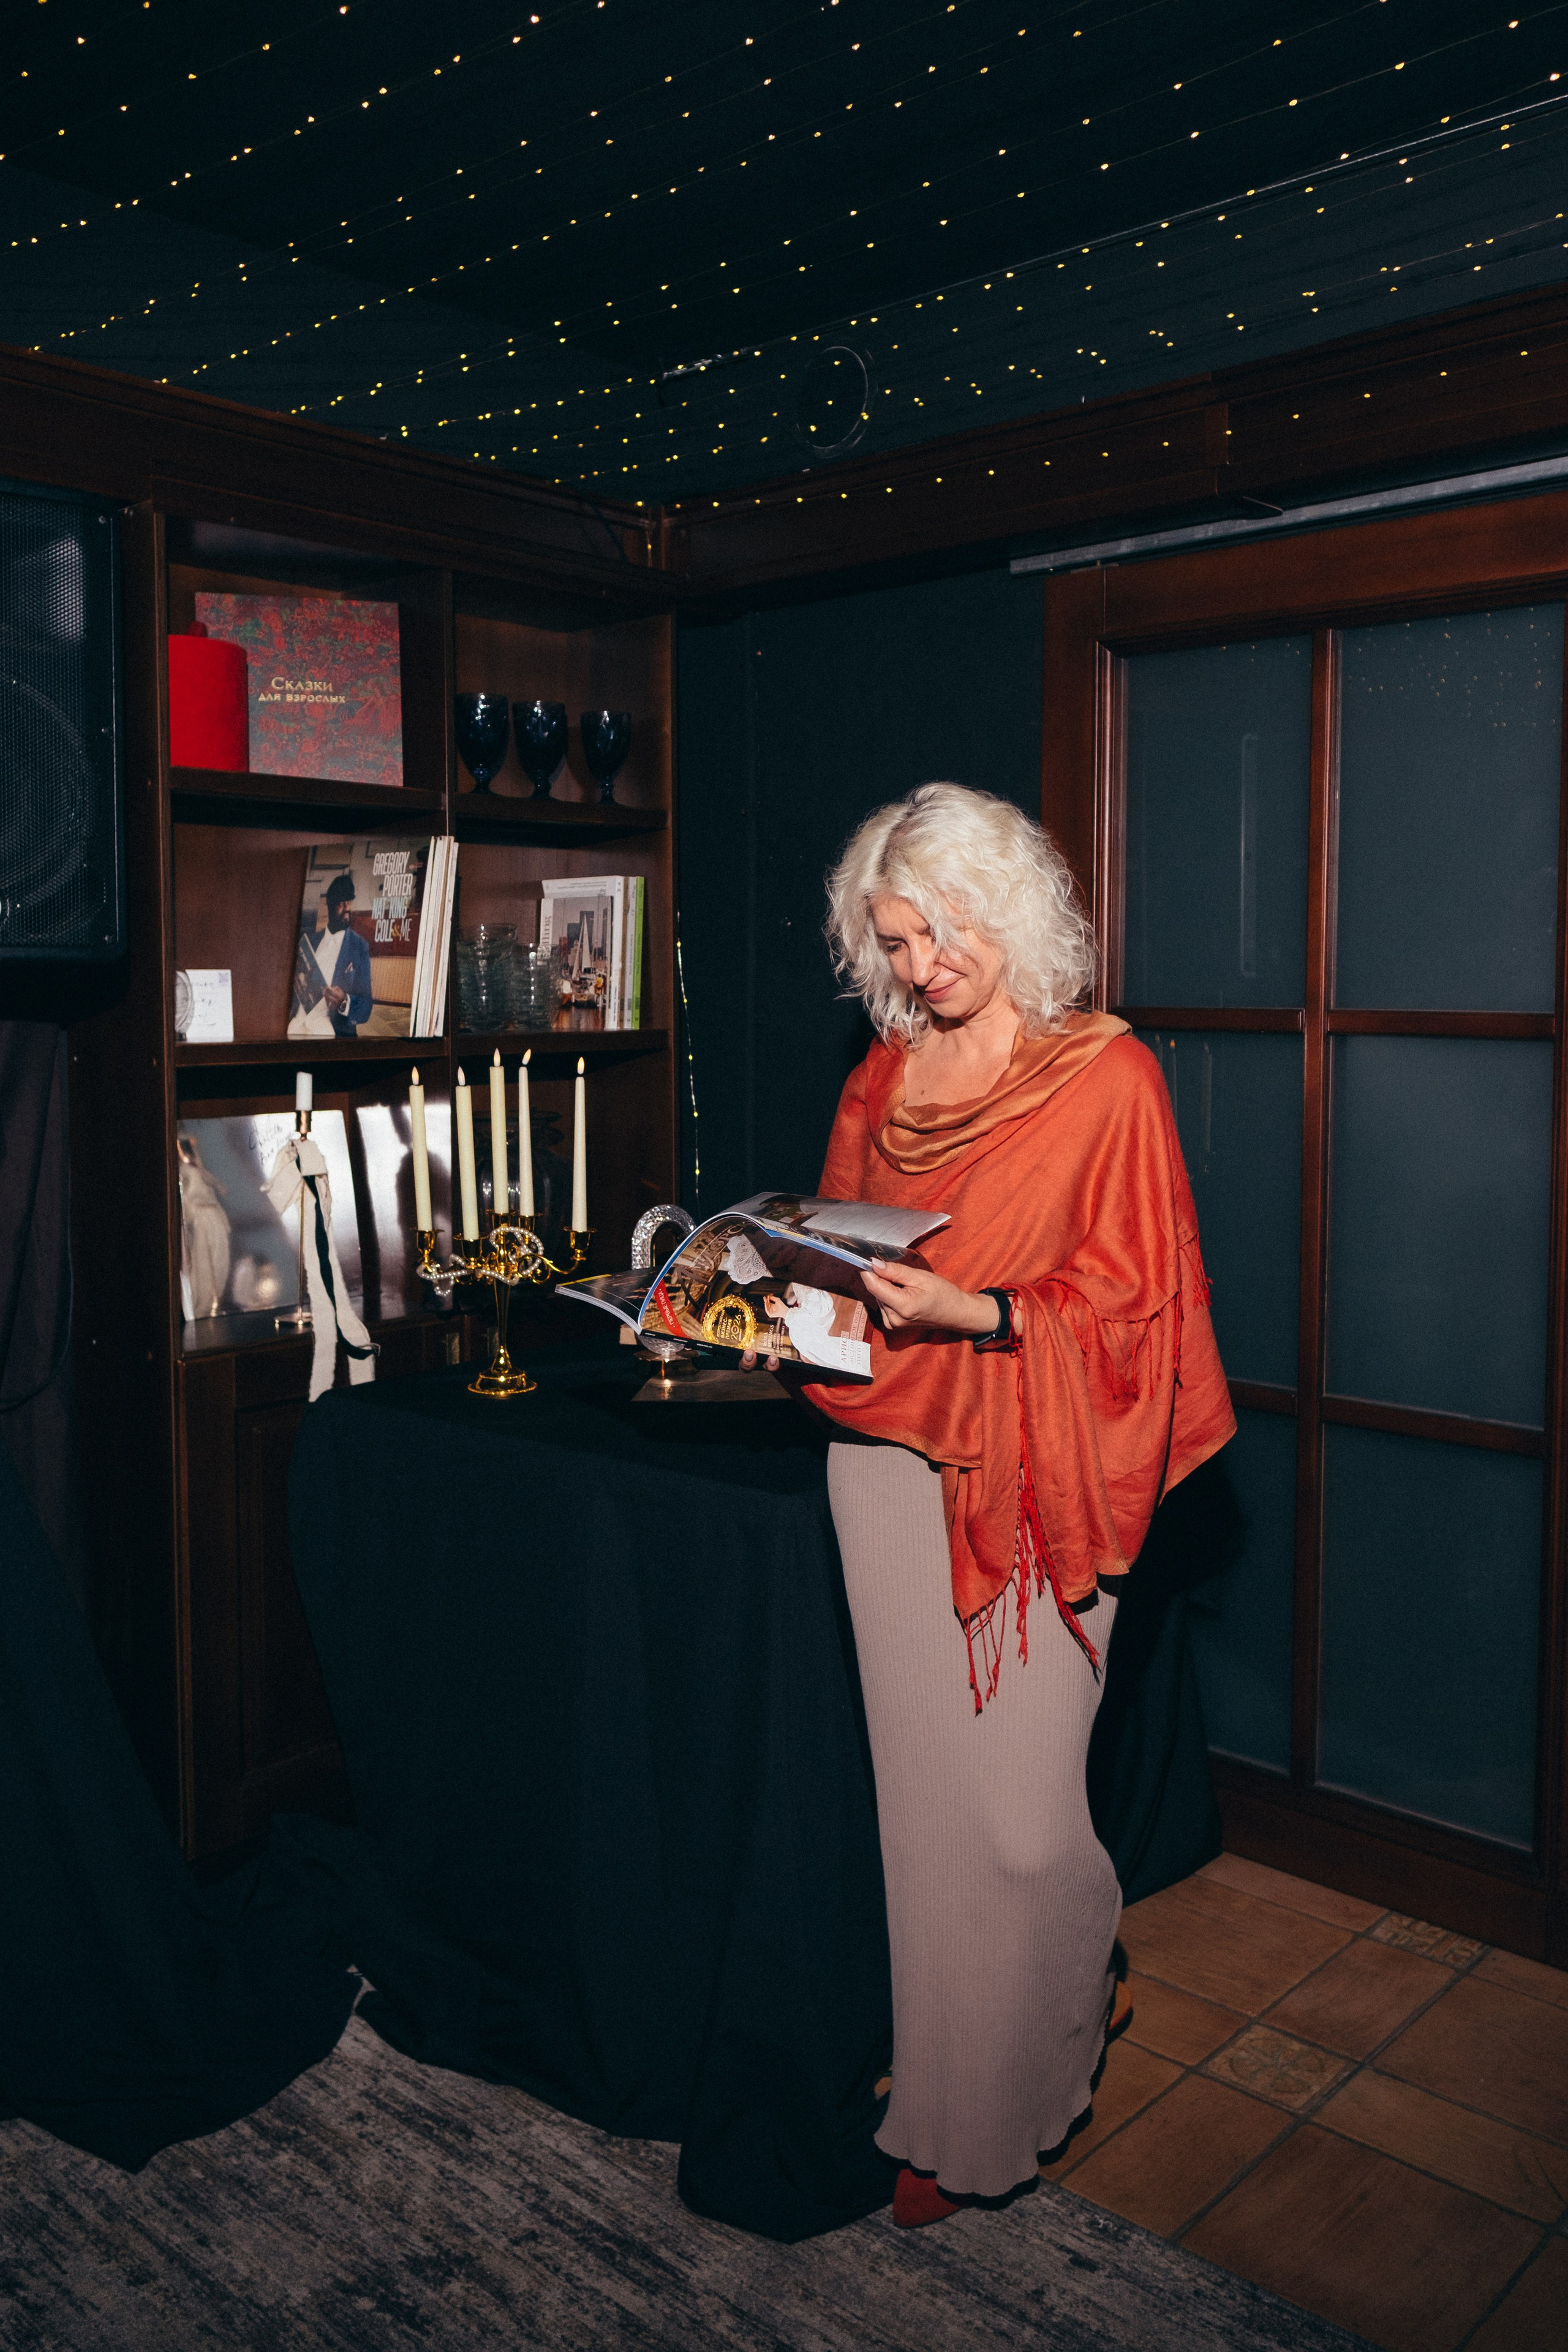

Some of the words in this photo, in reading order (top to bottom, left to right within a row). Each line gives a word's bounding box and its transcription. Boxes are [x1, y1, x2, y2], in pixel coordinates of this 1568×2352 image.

[372, 851, 410, 875] GREGORY
[382, 873, 413, 897] PORTER
[371, 897, 387, 919] NAT
[375, 919, 394, 943] COLE
[399, 919, 412, 941] ME
[663, 1304, 674, 1325] ПЕРВЫЕ
[731, 1314, 742, 1340] 2026
